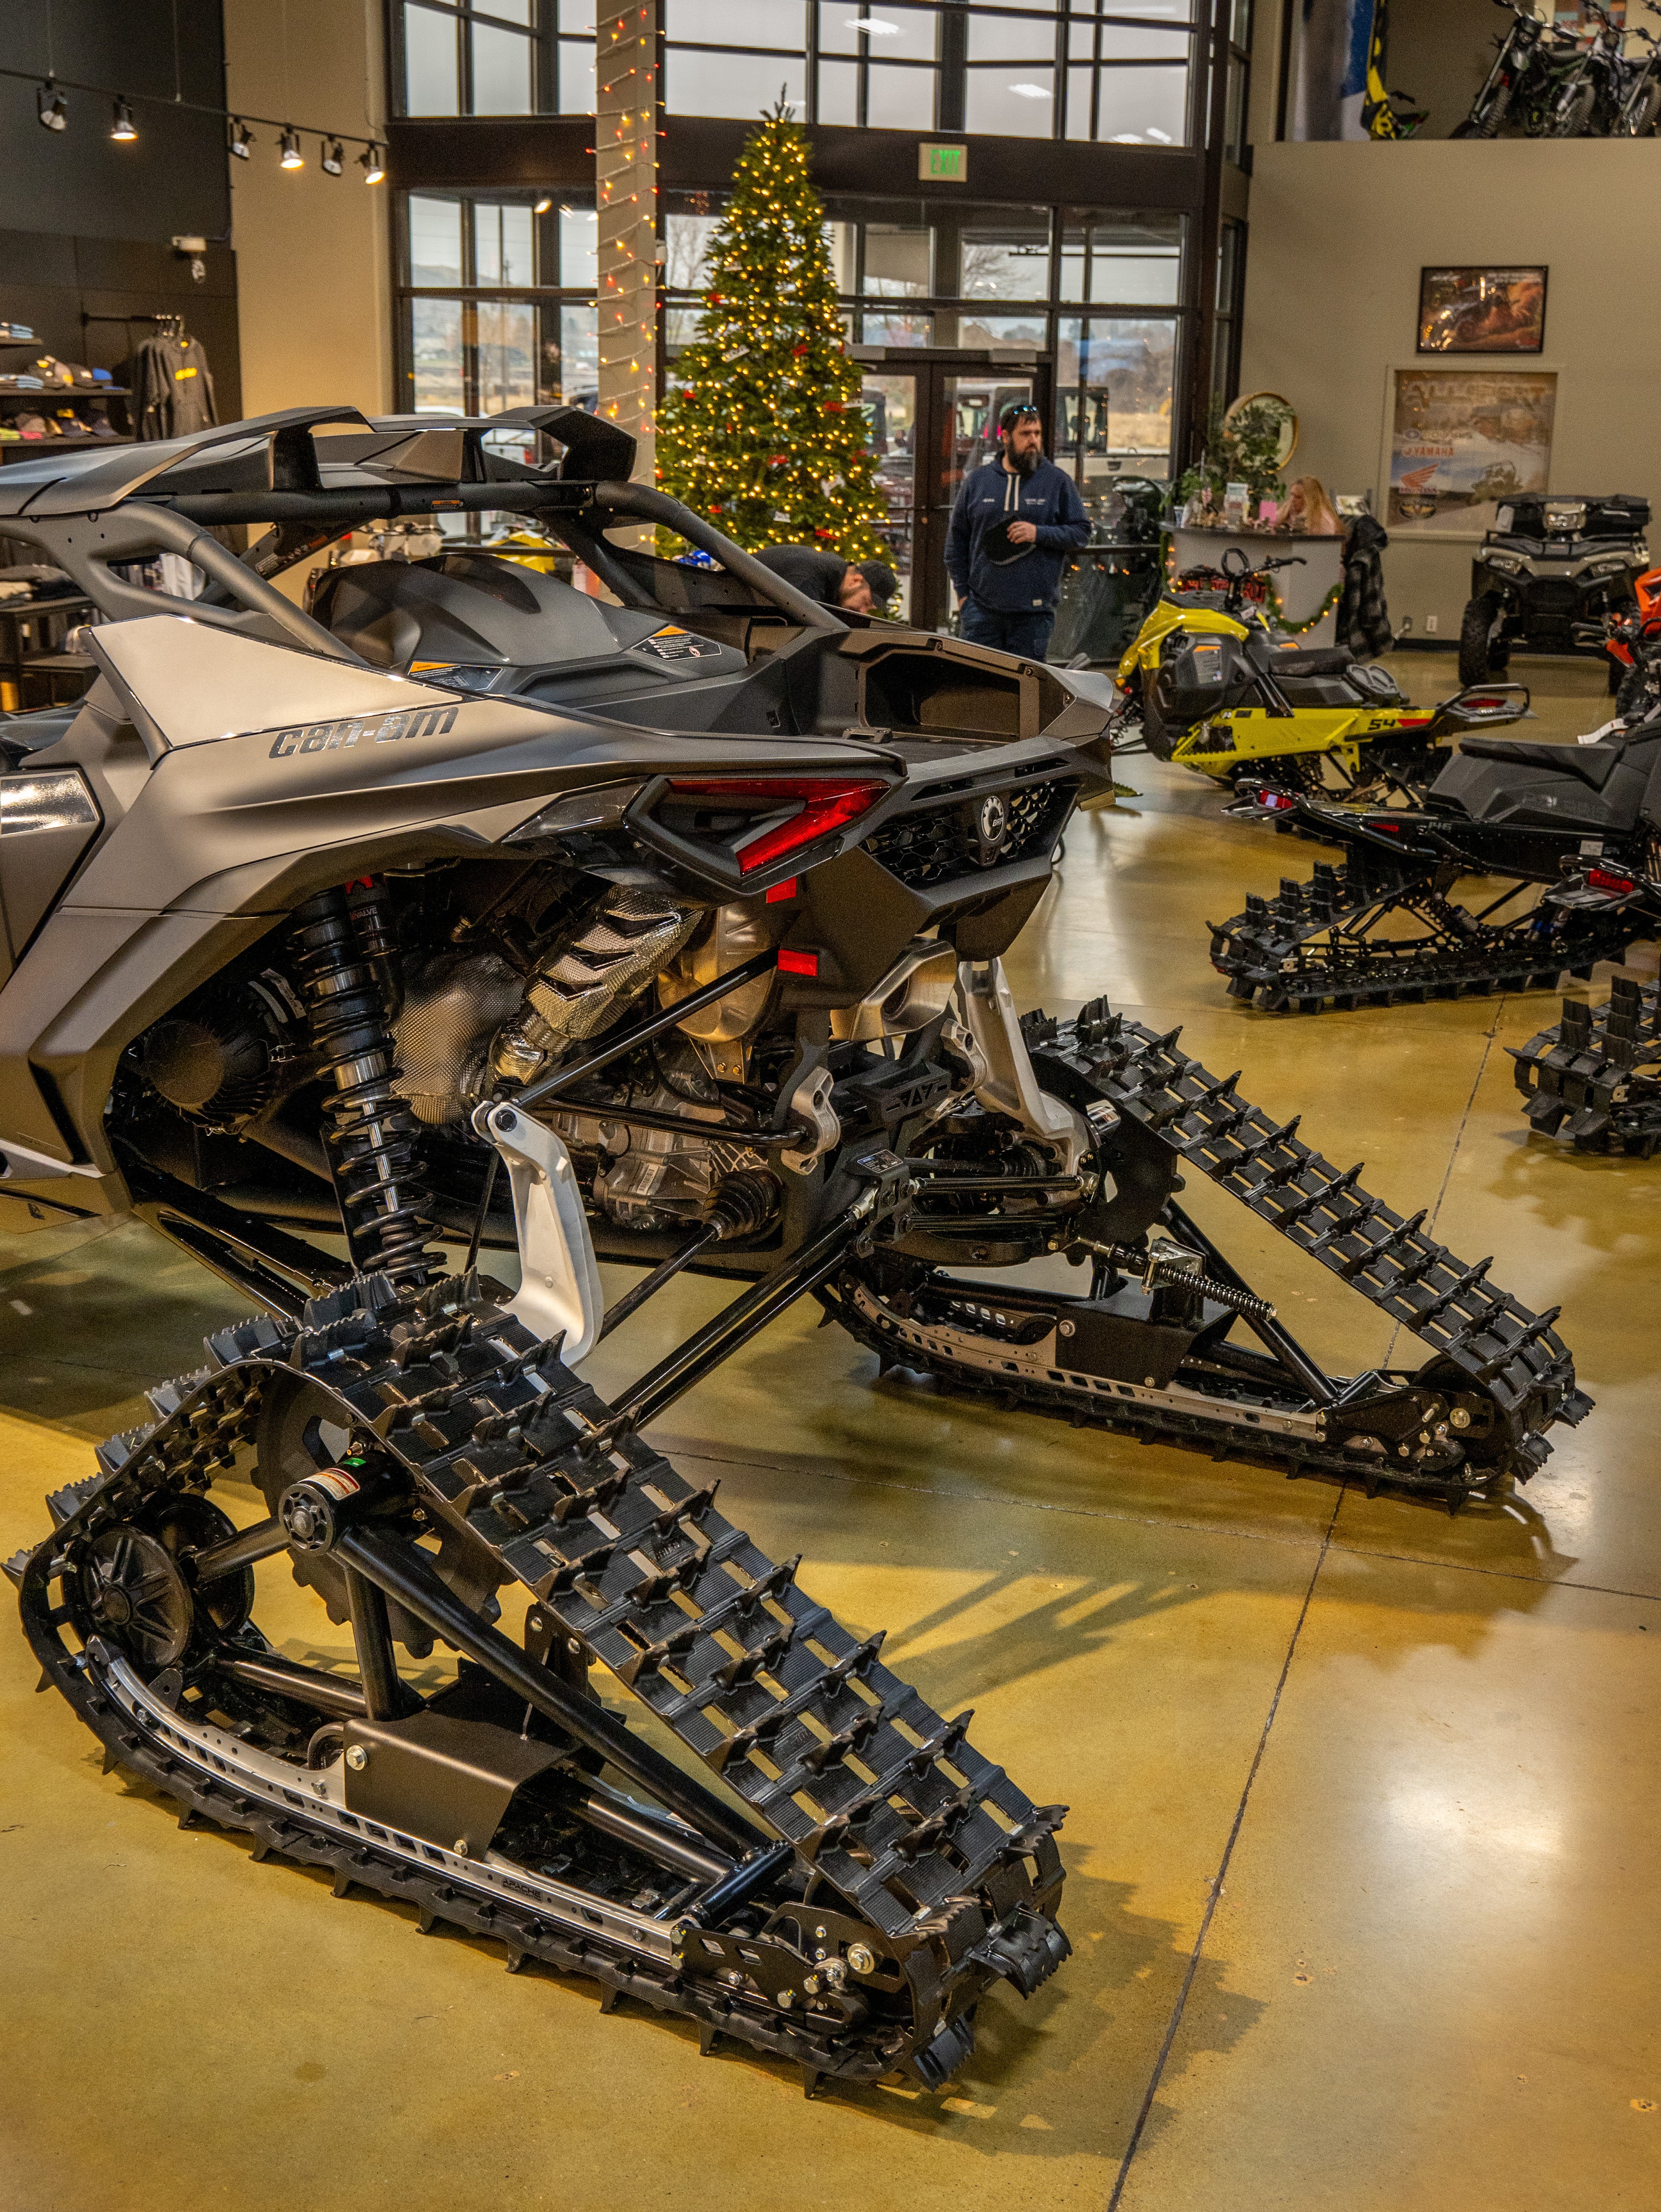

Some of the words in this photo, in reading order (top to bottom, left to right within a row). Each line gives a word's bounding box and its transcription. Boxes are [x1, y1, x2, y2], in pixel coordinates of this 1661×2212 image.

[930, 149, 961, 176] EXIT
[1414, 447, 1454, 457] YAMAHA
[992, 817, 1003, 827] BRP
[502, 1878, 541, 1898] APACHE
